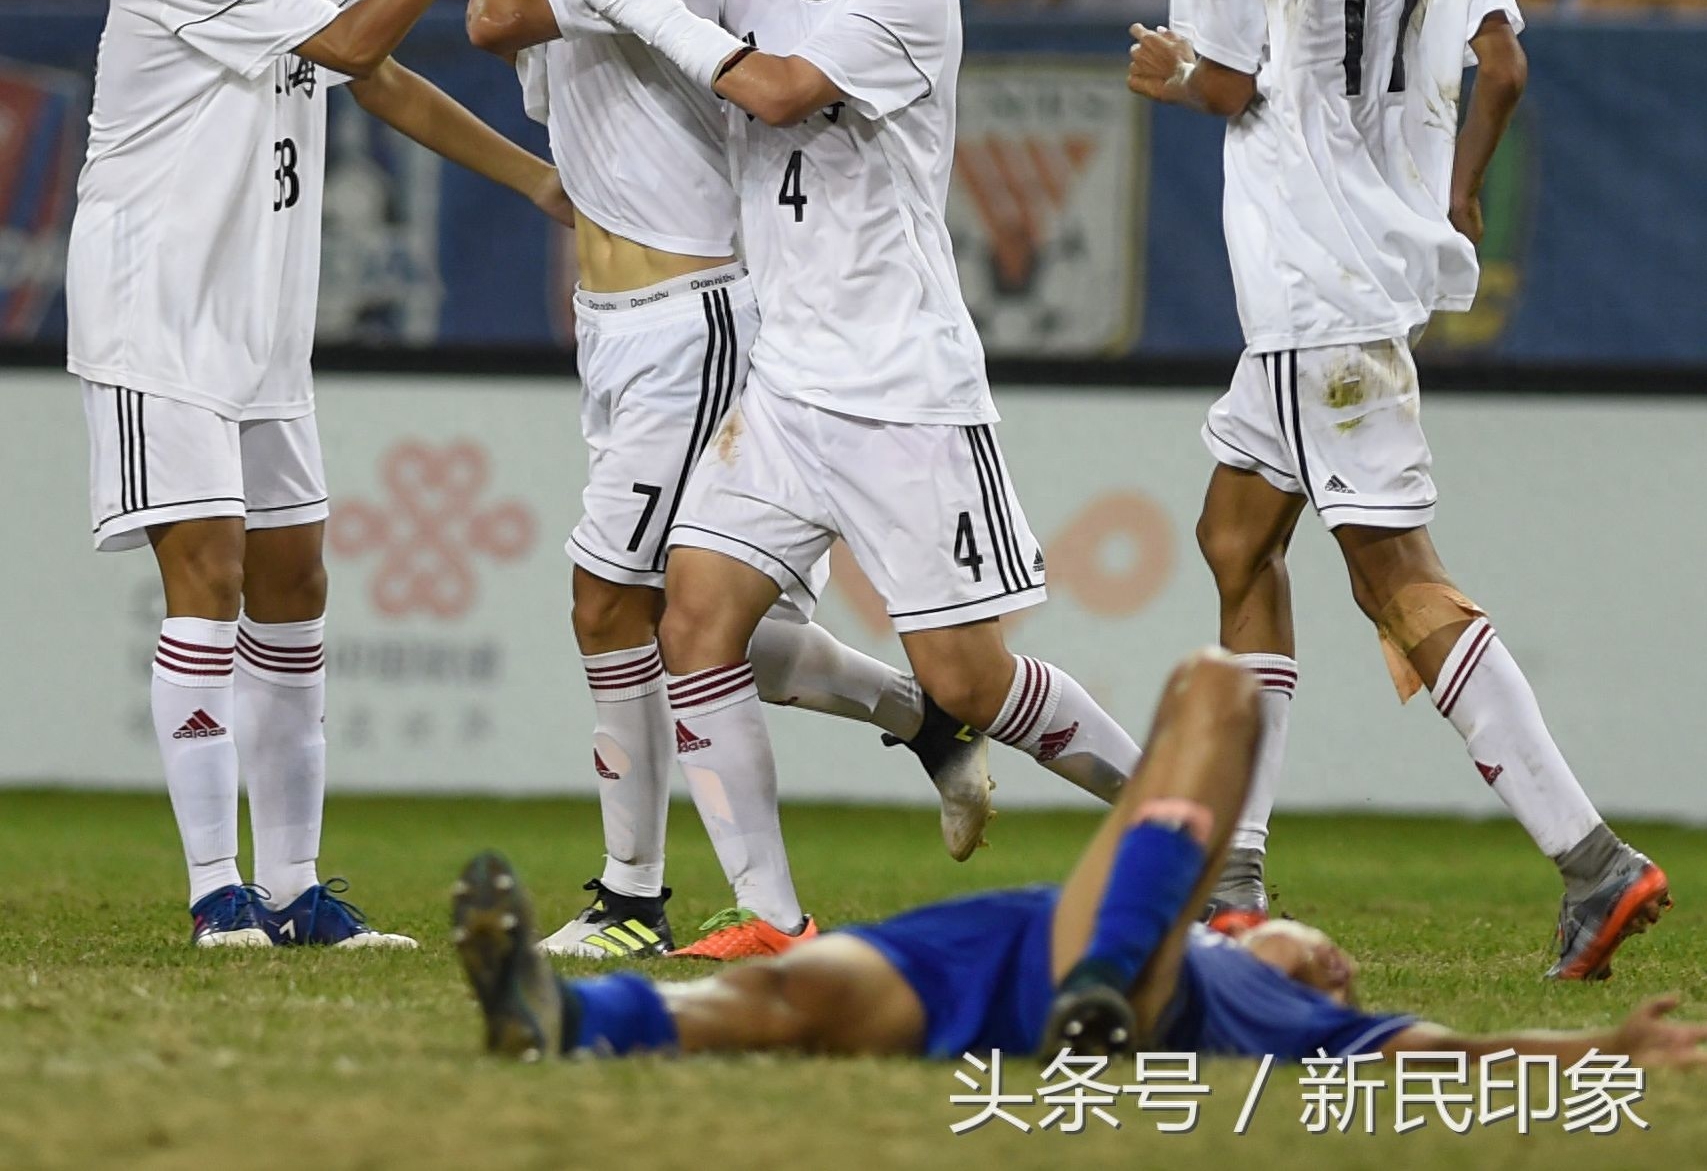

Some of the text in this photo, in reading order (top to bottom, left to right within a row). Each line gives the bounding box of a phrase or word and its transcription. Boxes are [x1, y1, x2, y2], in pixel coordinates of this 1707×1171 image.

[779, 150, 807, 222] 4
[627, 482, 662, 552] 7
[954, 511, 983, 583] 4
[172, 727, 227, 739] adidas
